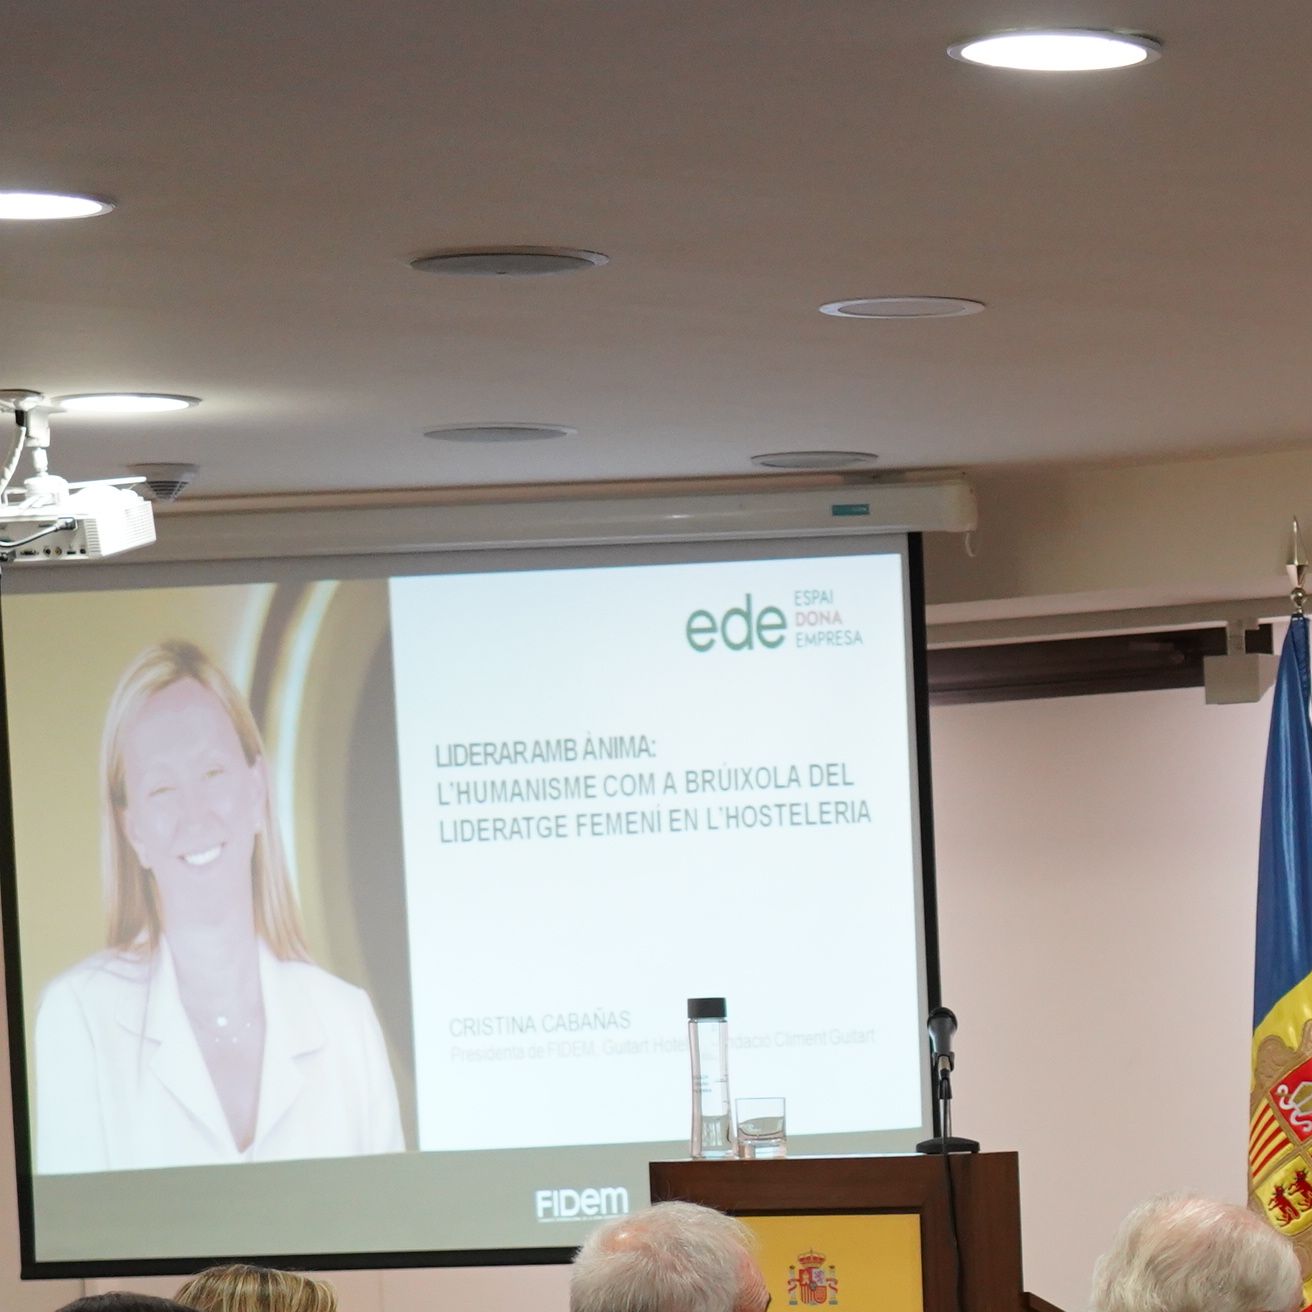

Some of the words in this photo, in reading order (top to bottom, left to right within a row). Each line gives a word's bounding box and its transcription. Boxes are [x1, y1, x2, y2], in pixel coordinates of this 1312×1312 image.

[794, 589, 834, 607] ESPAI
[685, 592, 788, 653] ede
[795, 610, 843, 627] DONA
[795, 630, 864, 648] EMPRESA
[435, 740, 529, 768] LIDERAR
[530, 738, 578, 763] AMB
[437, 775, 598, 806] L'HUMANISME
[603, 772, 656, 798] COM
[662, 771, 678, 795] A
[808, 762, 855, 788] DEL
[439, 814, 568, 844] LIDERATGE
[668, 806, 699, 832] EN
[706, 799, 872, 831] L'HOSTELERIA
[448, 1014, 538, 1038] CRISTINA
[541, 1006, 632, 1034] CABAÑAS
